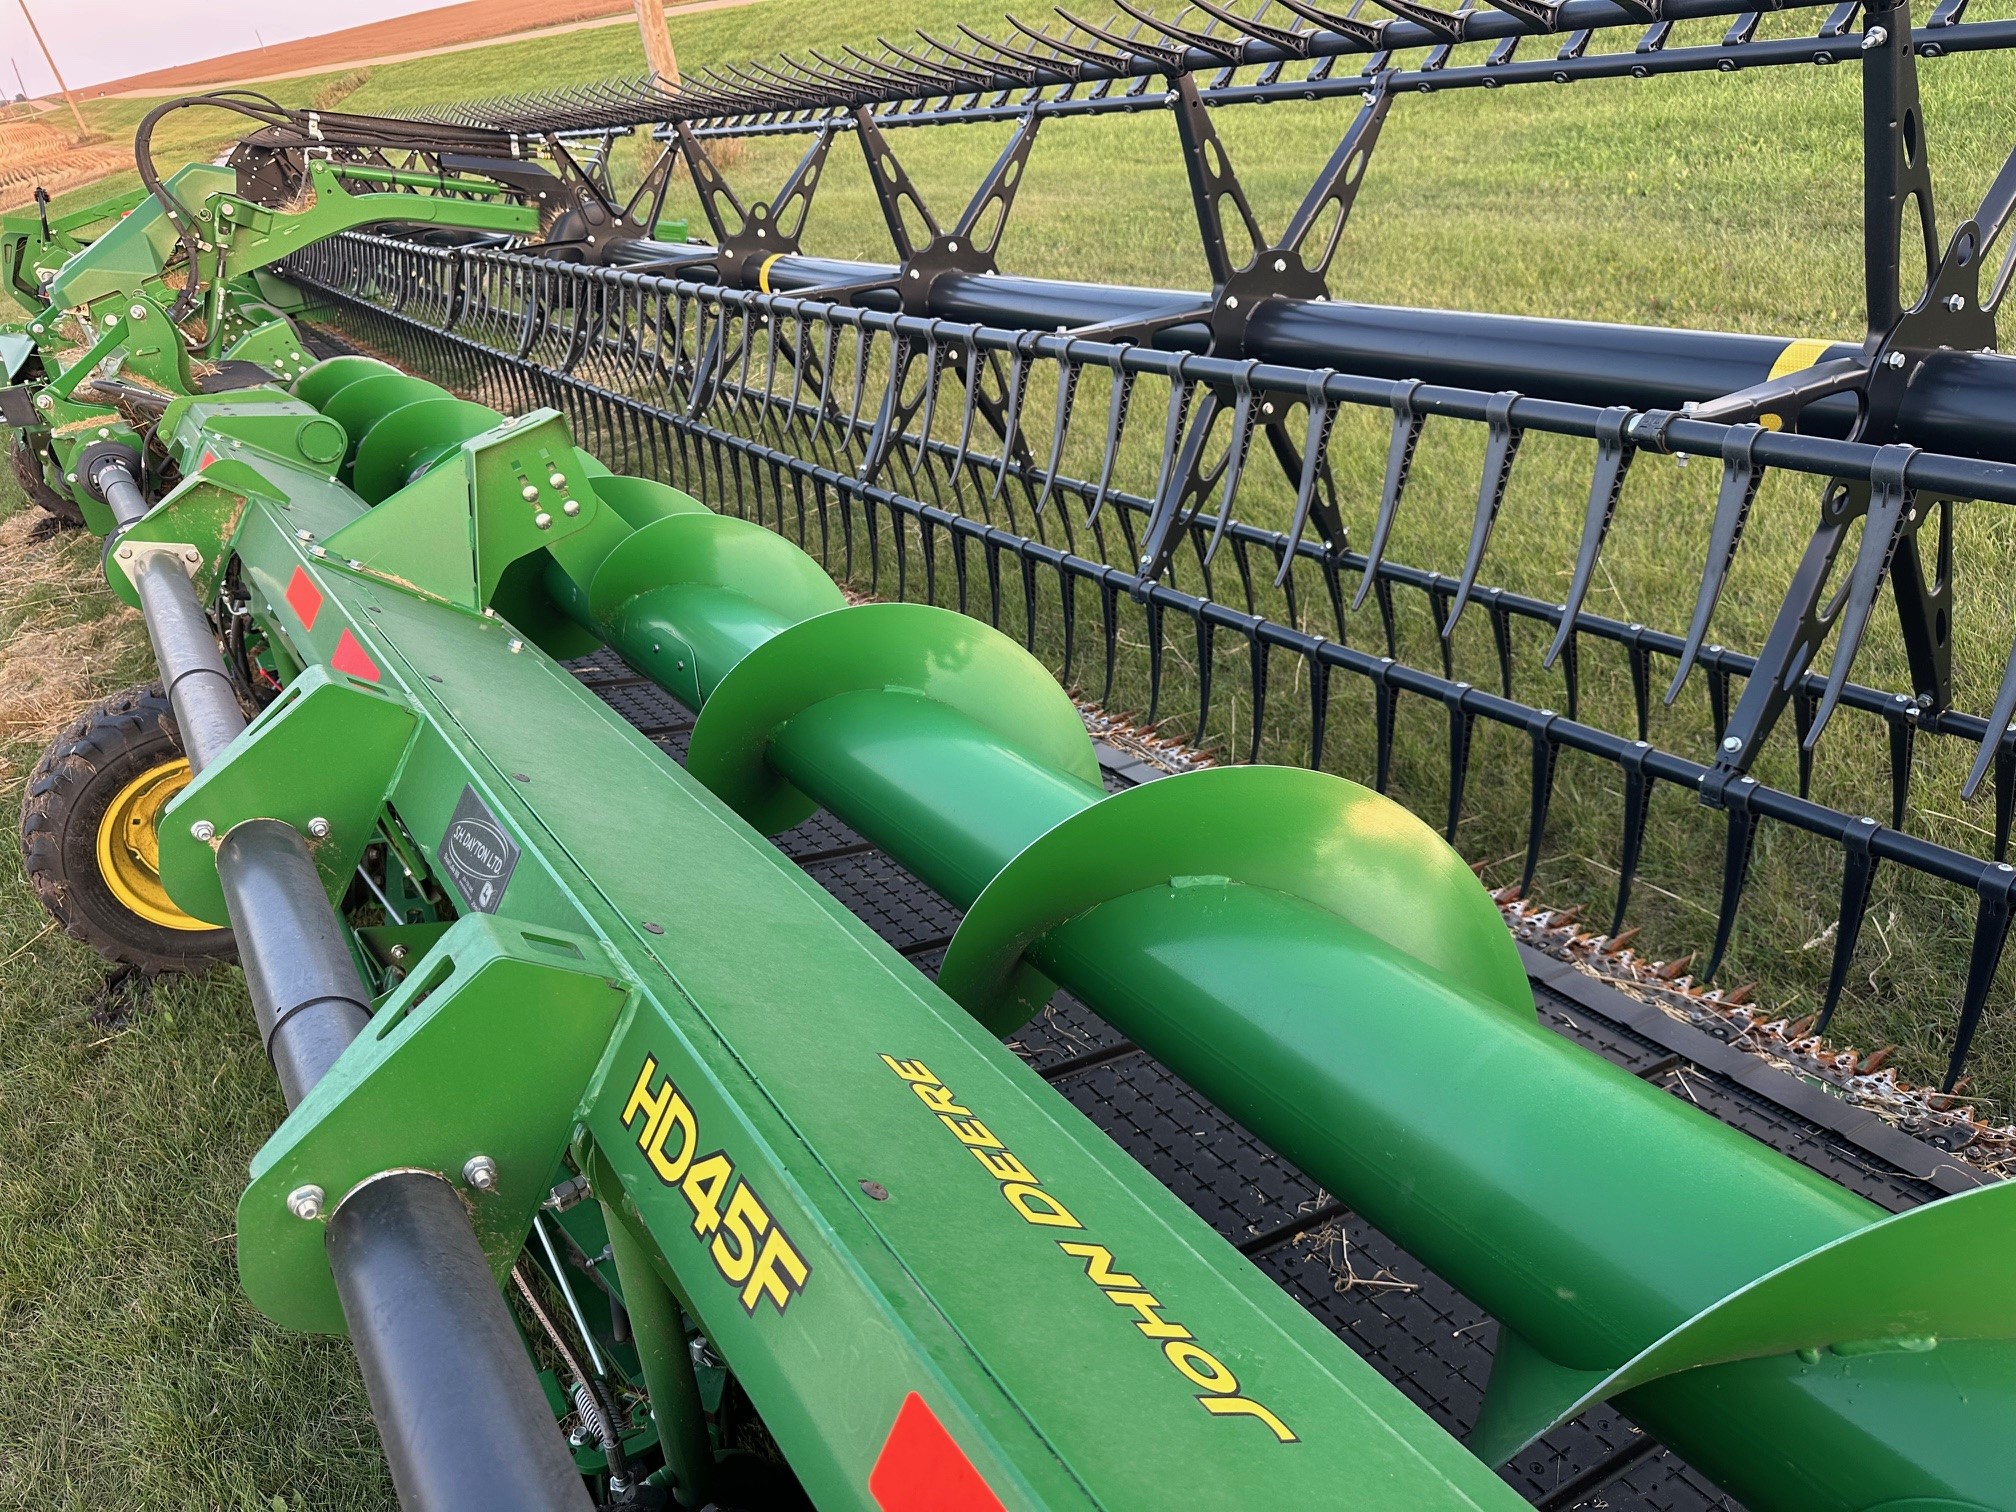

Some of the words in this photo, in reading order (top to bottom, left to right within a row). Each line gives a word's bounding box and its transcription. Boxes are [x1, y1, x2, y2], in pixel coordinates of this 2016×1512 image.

[462, 832, 491, 864] DAYTON
[619, 1051, 812, 1317] HD45F
[877, 1053, 1088, 1230] DEERE
[1055, 1240, 1301, 1444] JOHN
